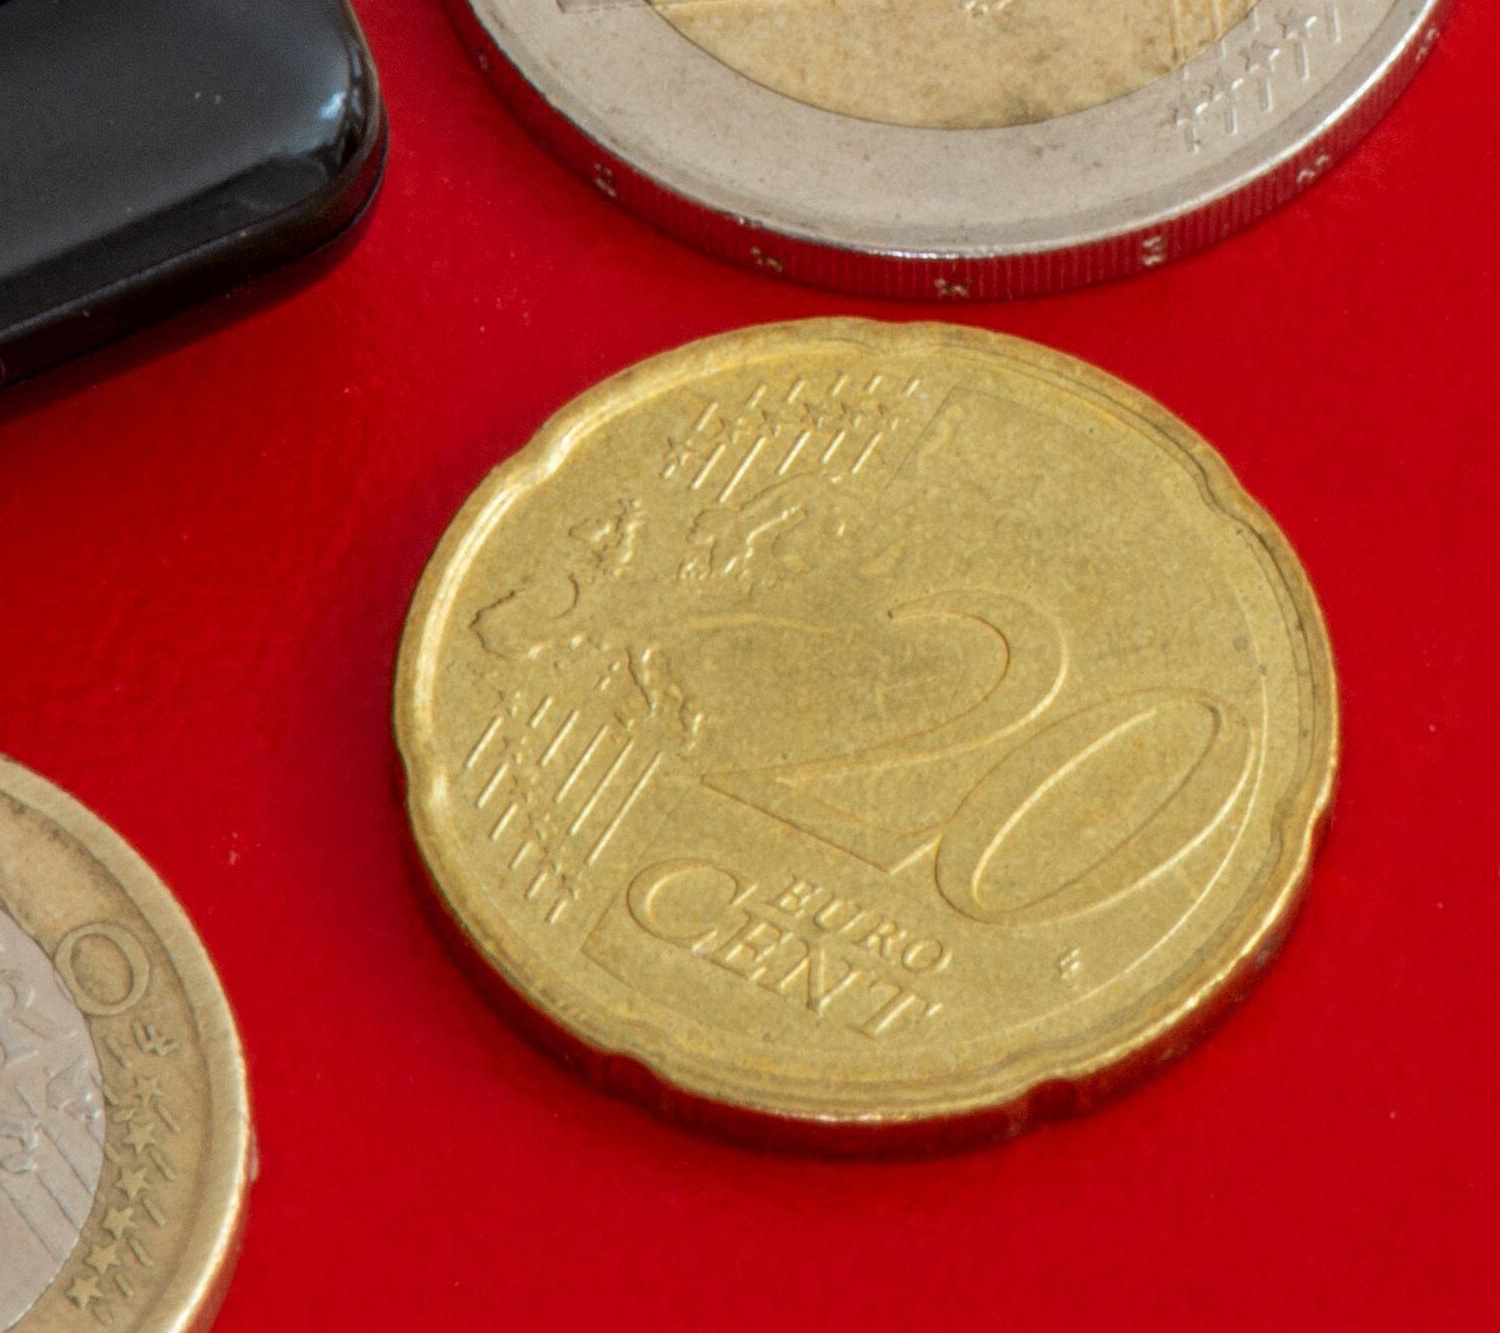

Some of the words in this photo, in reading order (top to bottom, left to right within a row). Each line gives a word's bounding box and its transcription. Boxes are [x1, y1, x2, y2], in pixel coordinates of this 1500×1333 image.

[700, 590, 1261, 924] 20
[626, 857, 945, 1040] CENT
[764, 878, 953, 974] EURO
